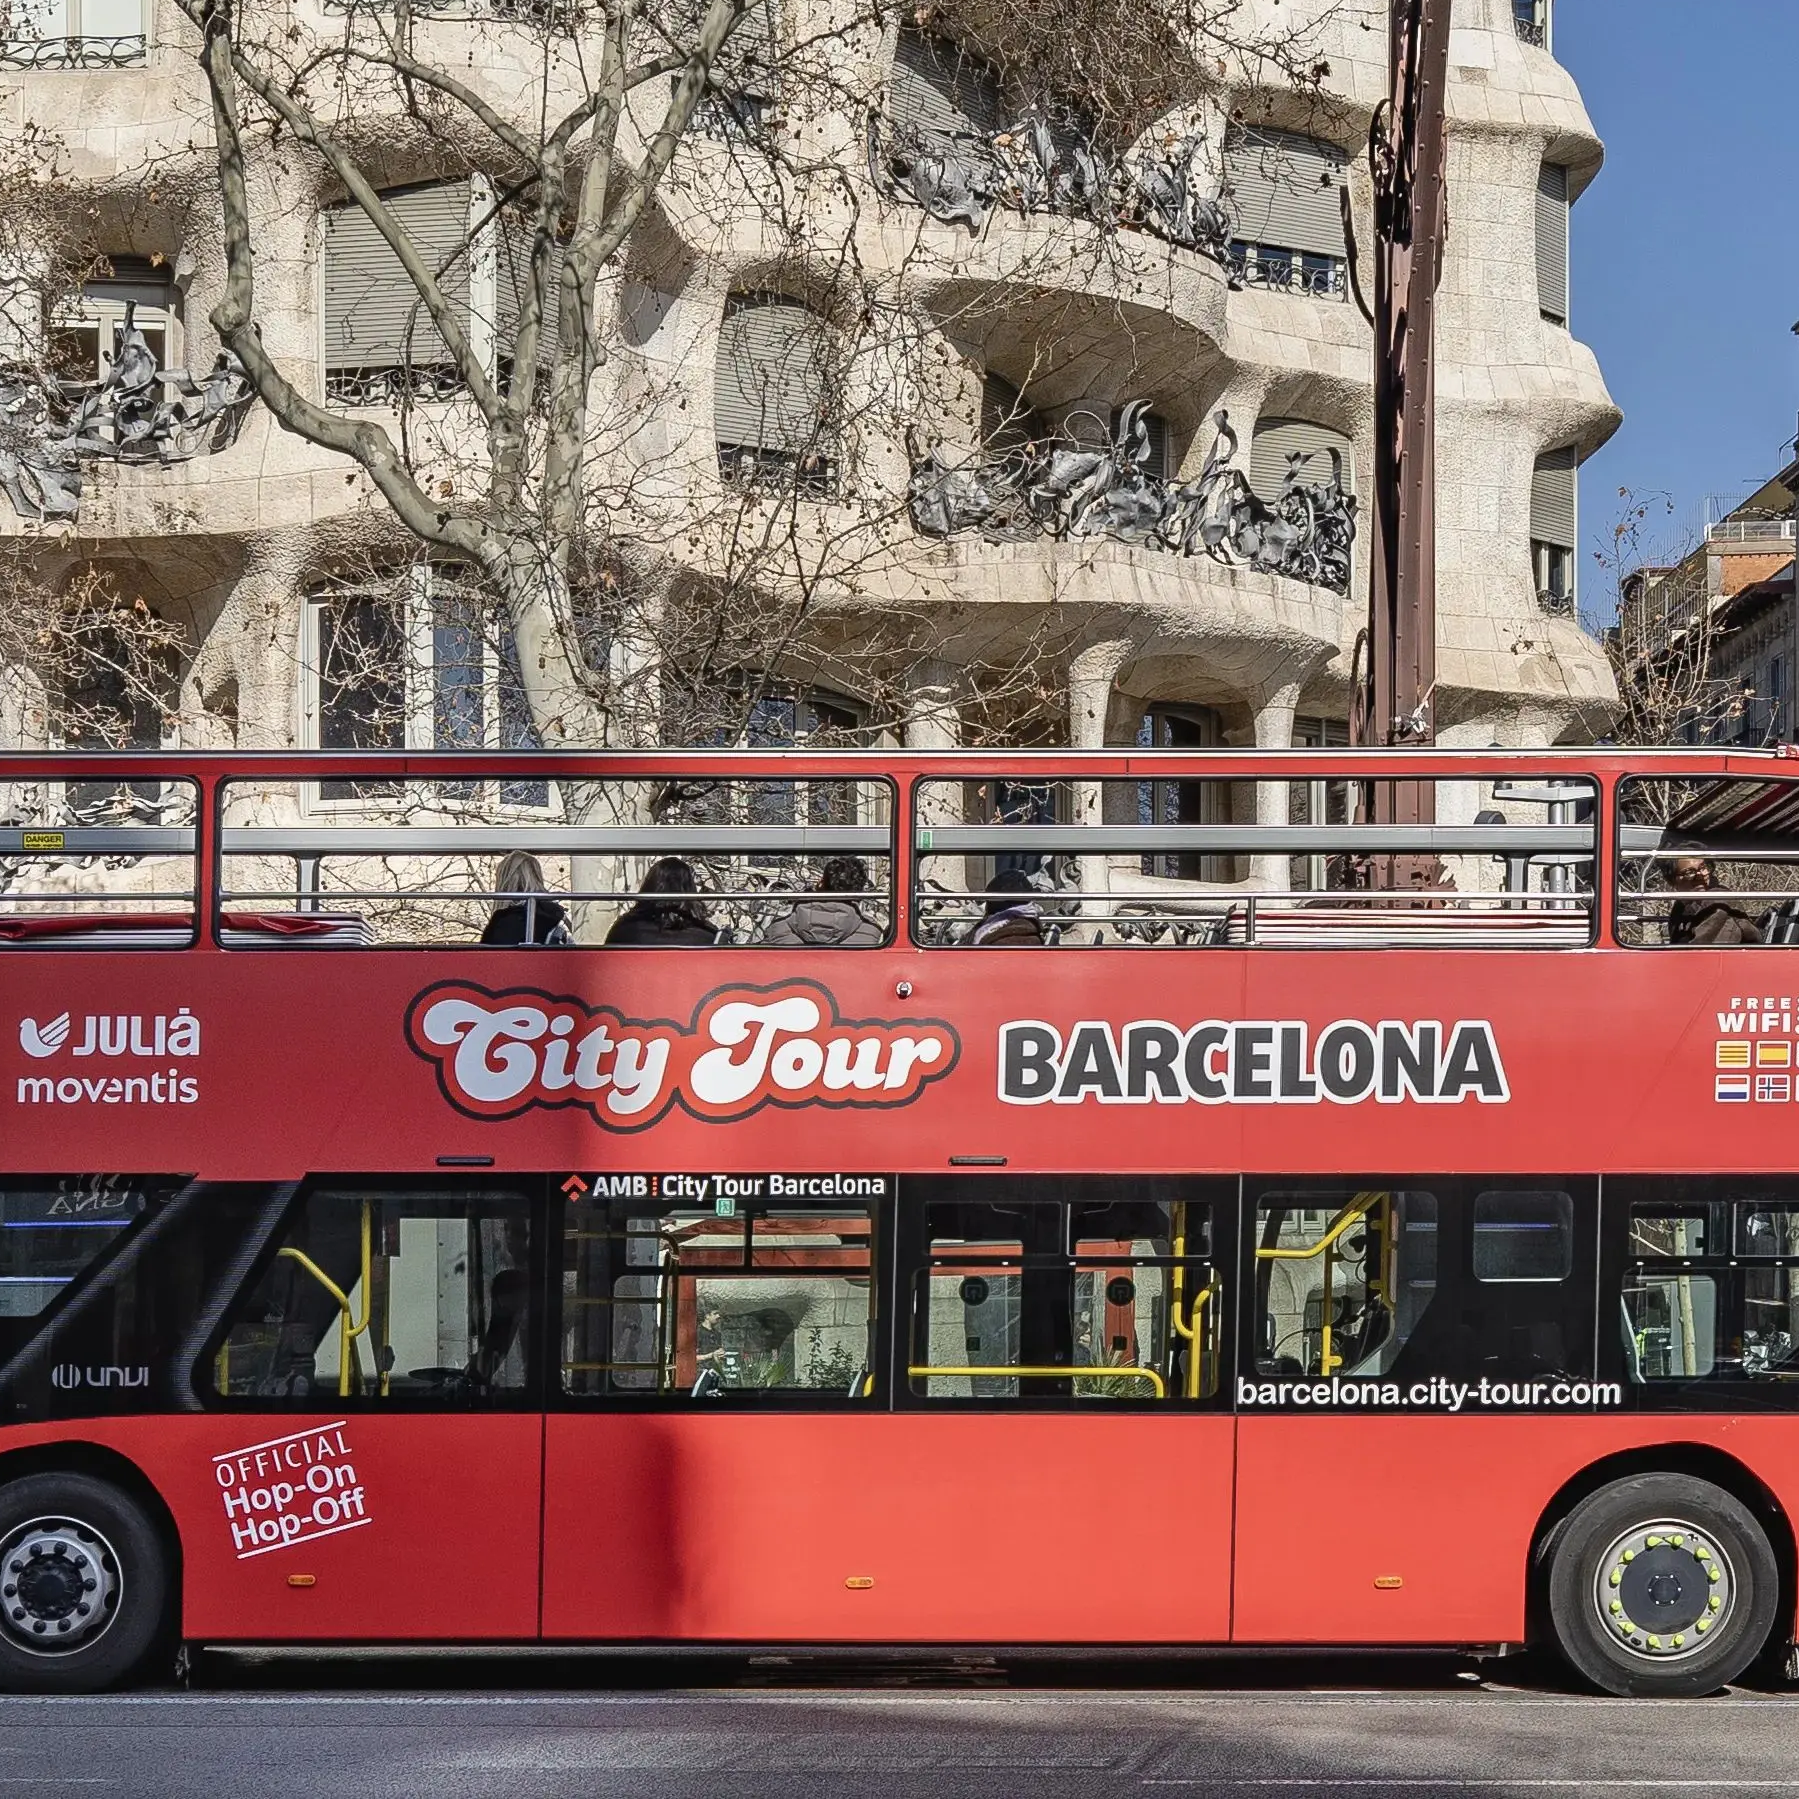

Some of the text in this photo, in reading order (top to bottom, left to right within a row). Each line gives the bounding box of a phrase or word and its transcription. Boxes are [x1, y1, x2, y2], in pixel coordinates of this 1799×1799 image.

[1716, 1012, 1792, 1033] WIFI
[1731, 997, 1792, 1010] FREE
[422, 997, 943, 1115] City Tour
[1000, 1020, 1510, 1104] BARCELONA
[17, 1068, 199, 1104] moventis
[593, 1174, 886, 1201] AMB City Tour Barcelona
[1237, 1377, 1622, 1411] barcelona.city-tour.com
[216, 1431, 352, 1487] OFFICIAL
[223, 1464, 356, 1518] Hop-On
[231, 1487, 365, 1550] Hop-Off
